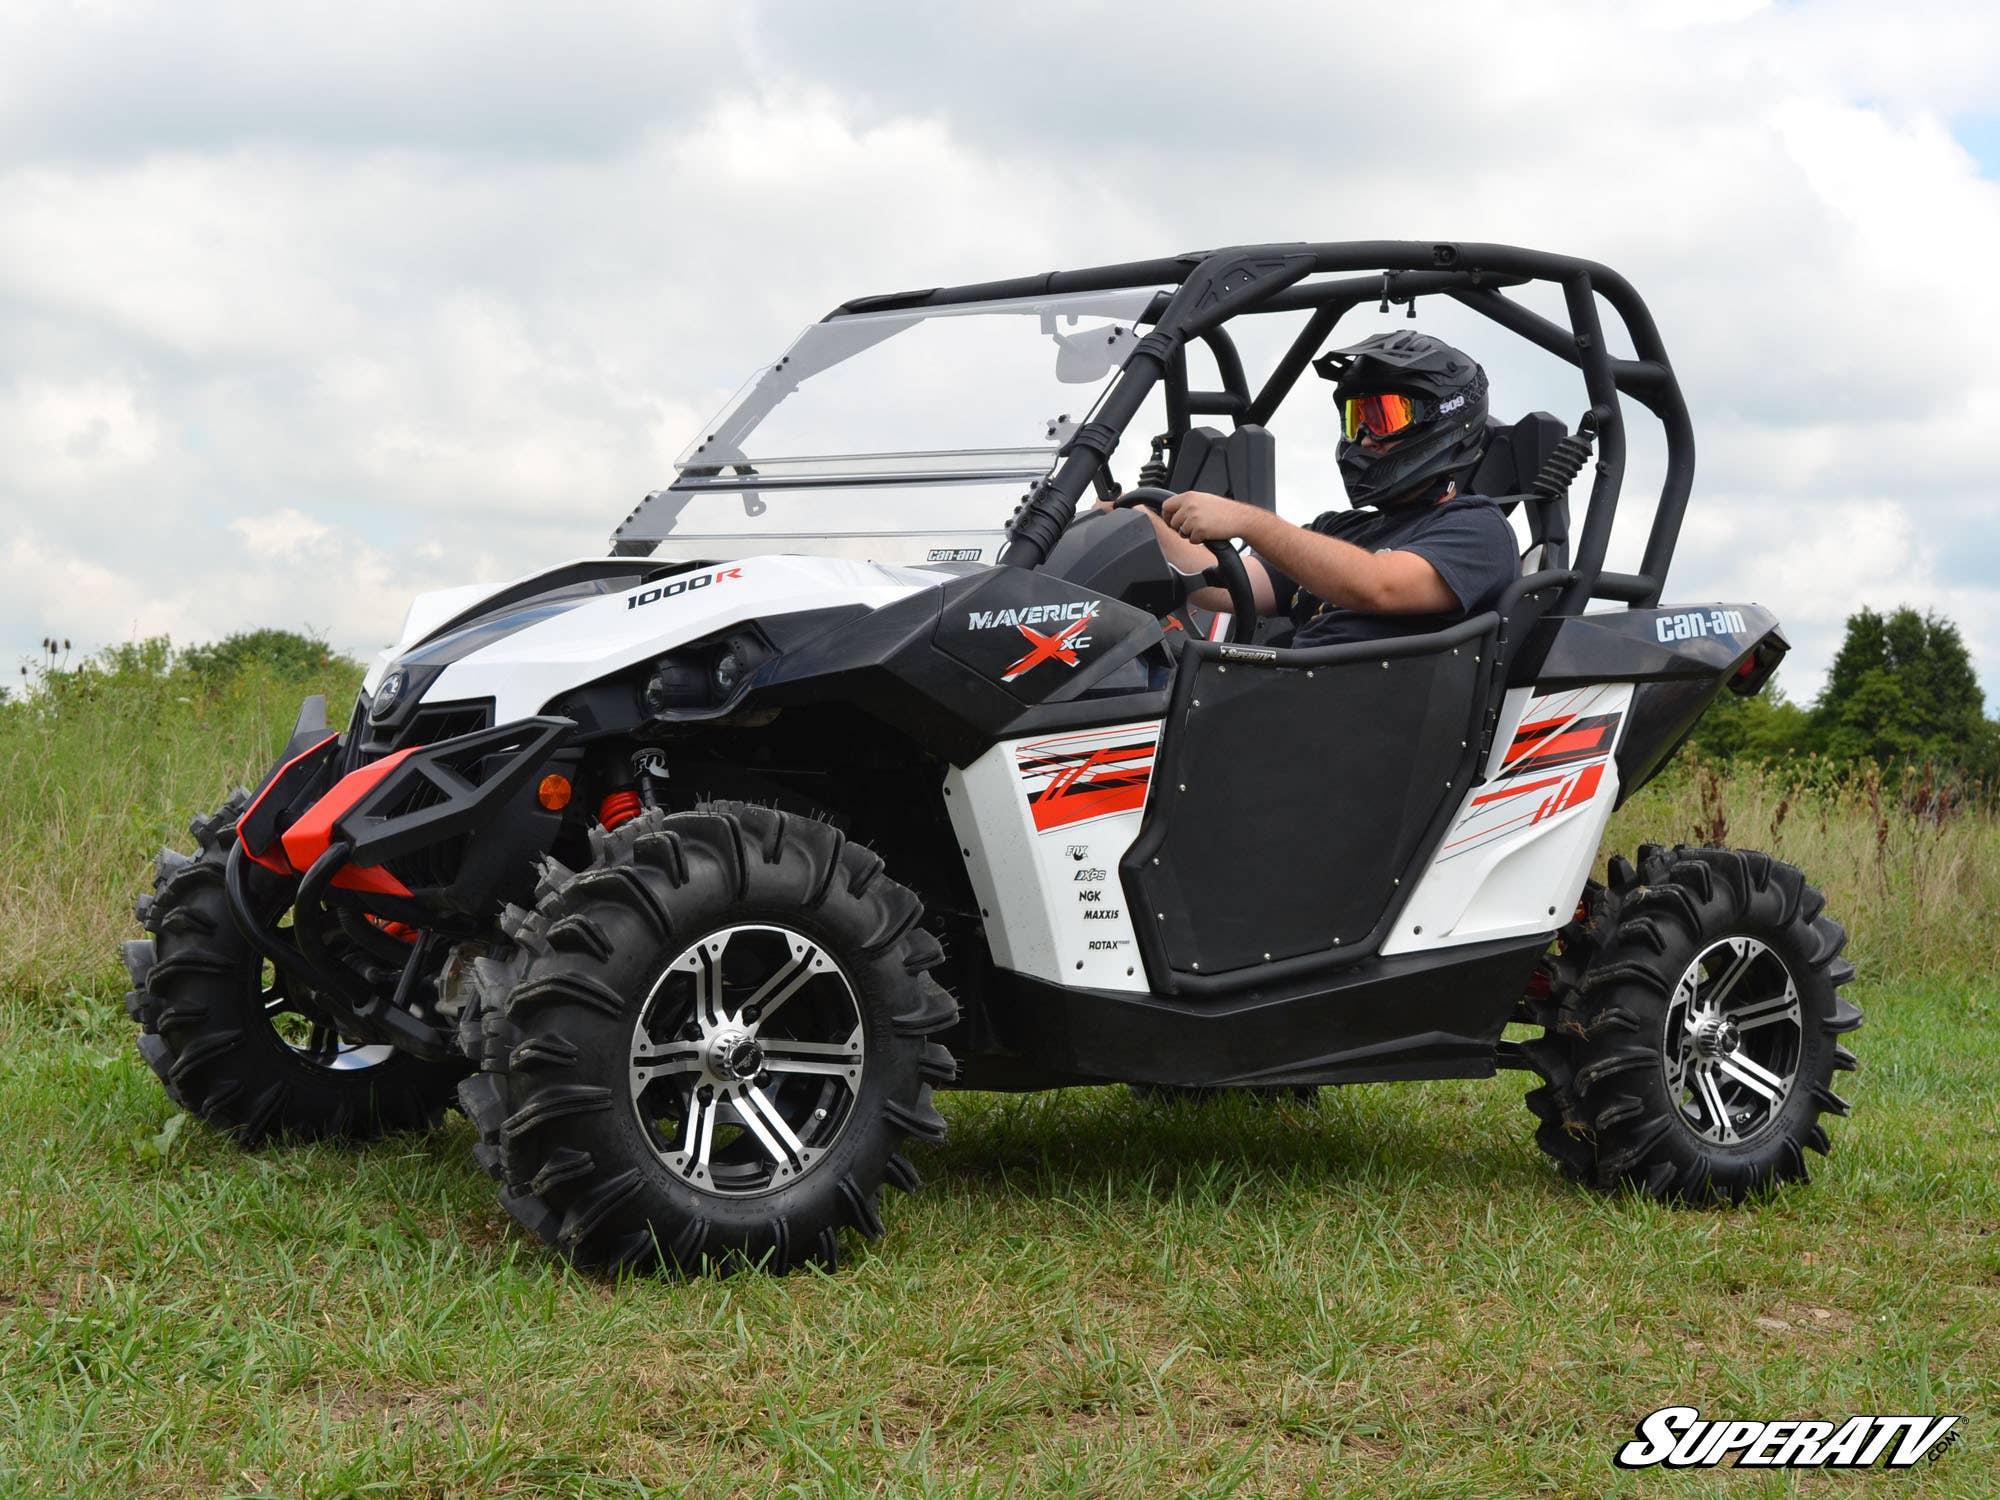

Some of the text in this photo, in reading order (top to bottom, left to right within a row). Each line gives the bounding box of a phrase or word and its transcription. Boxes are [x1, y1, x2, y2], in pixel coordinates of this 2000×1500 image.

[628, 567, 743, 610] 1000R
[968, 600, 1101, 631] MAVERICK
[1079, 890, 1101, 902] NGK
[1084, 910, 1119, 920] MAXXIS
[1088, 941, 1118, 950] ROTAX
